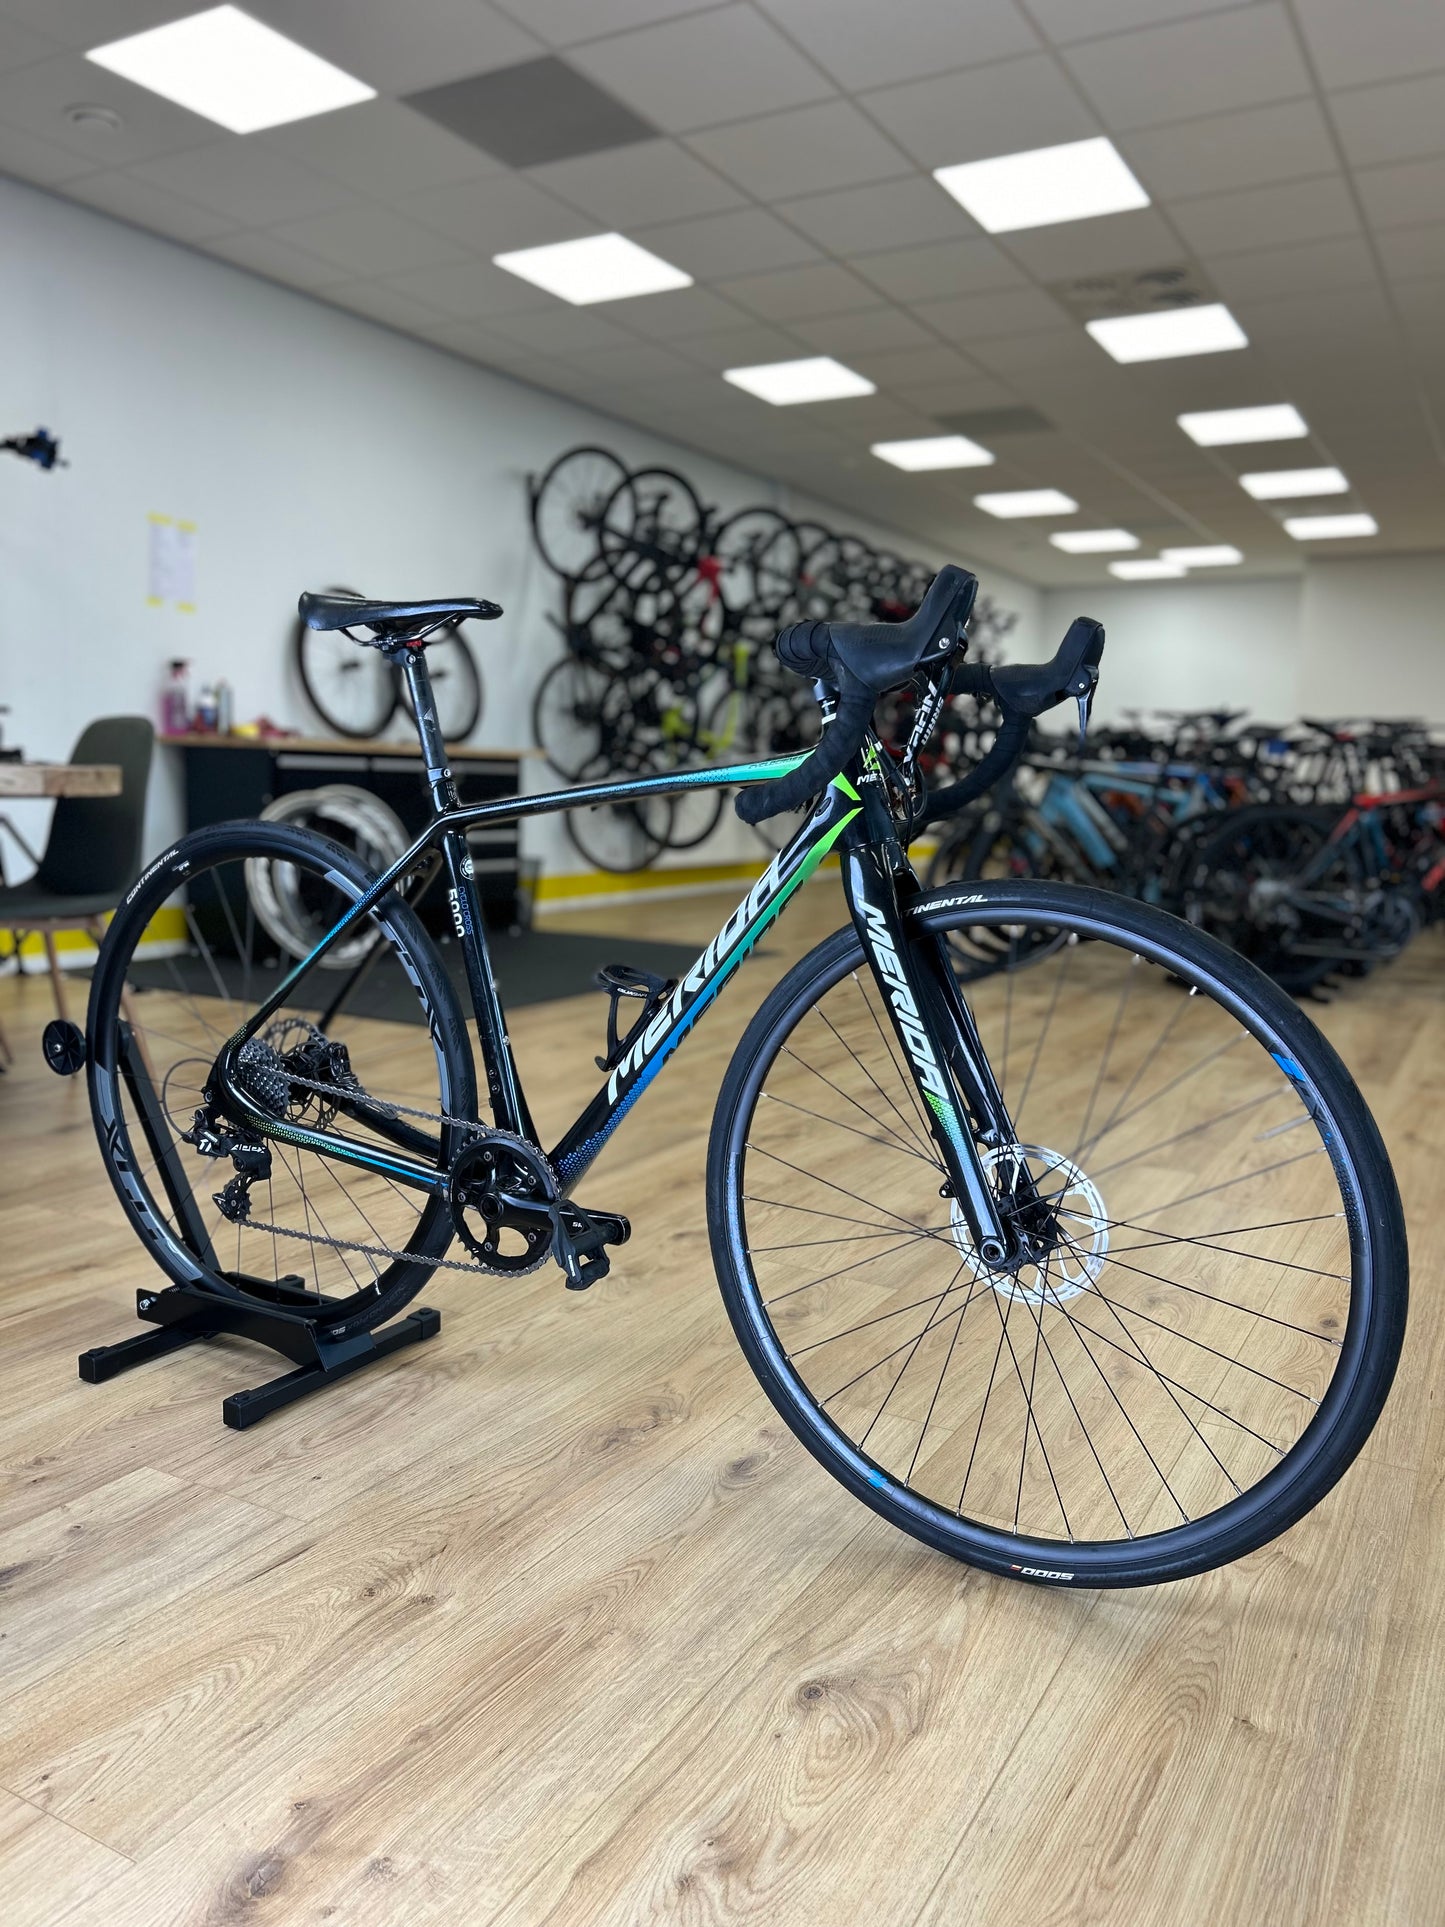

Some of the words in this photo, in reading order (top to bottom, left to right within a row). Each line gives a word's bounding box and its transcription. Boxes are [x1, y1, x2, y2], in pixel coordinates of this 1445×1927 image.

[920, 696, 944, 746] SRAM
[126, 848, 179, 905] CONTINENTAL
[458, 887, 470, 909] CYCLO
[448, 888, 465, 937] 5000
[463, 910, 473, 935] CROSS
[904, 894, 989, 918] TINENTAL
[607, 848, 785, 1106] MERIDA
[857, 898, 950, 1101] MERIDA
[1020, 1568, 1075, 1580] 5000
